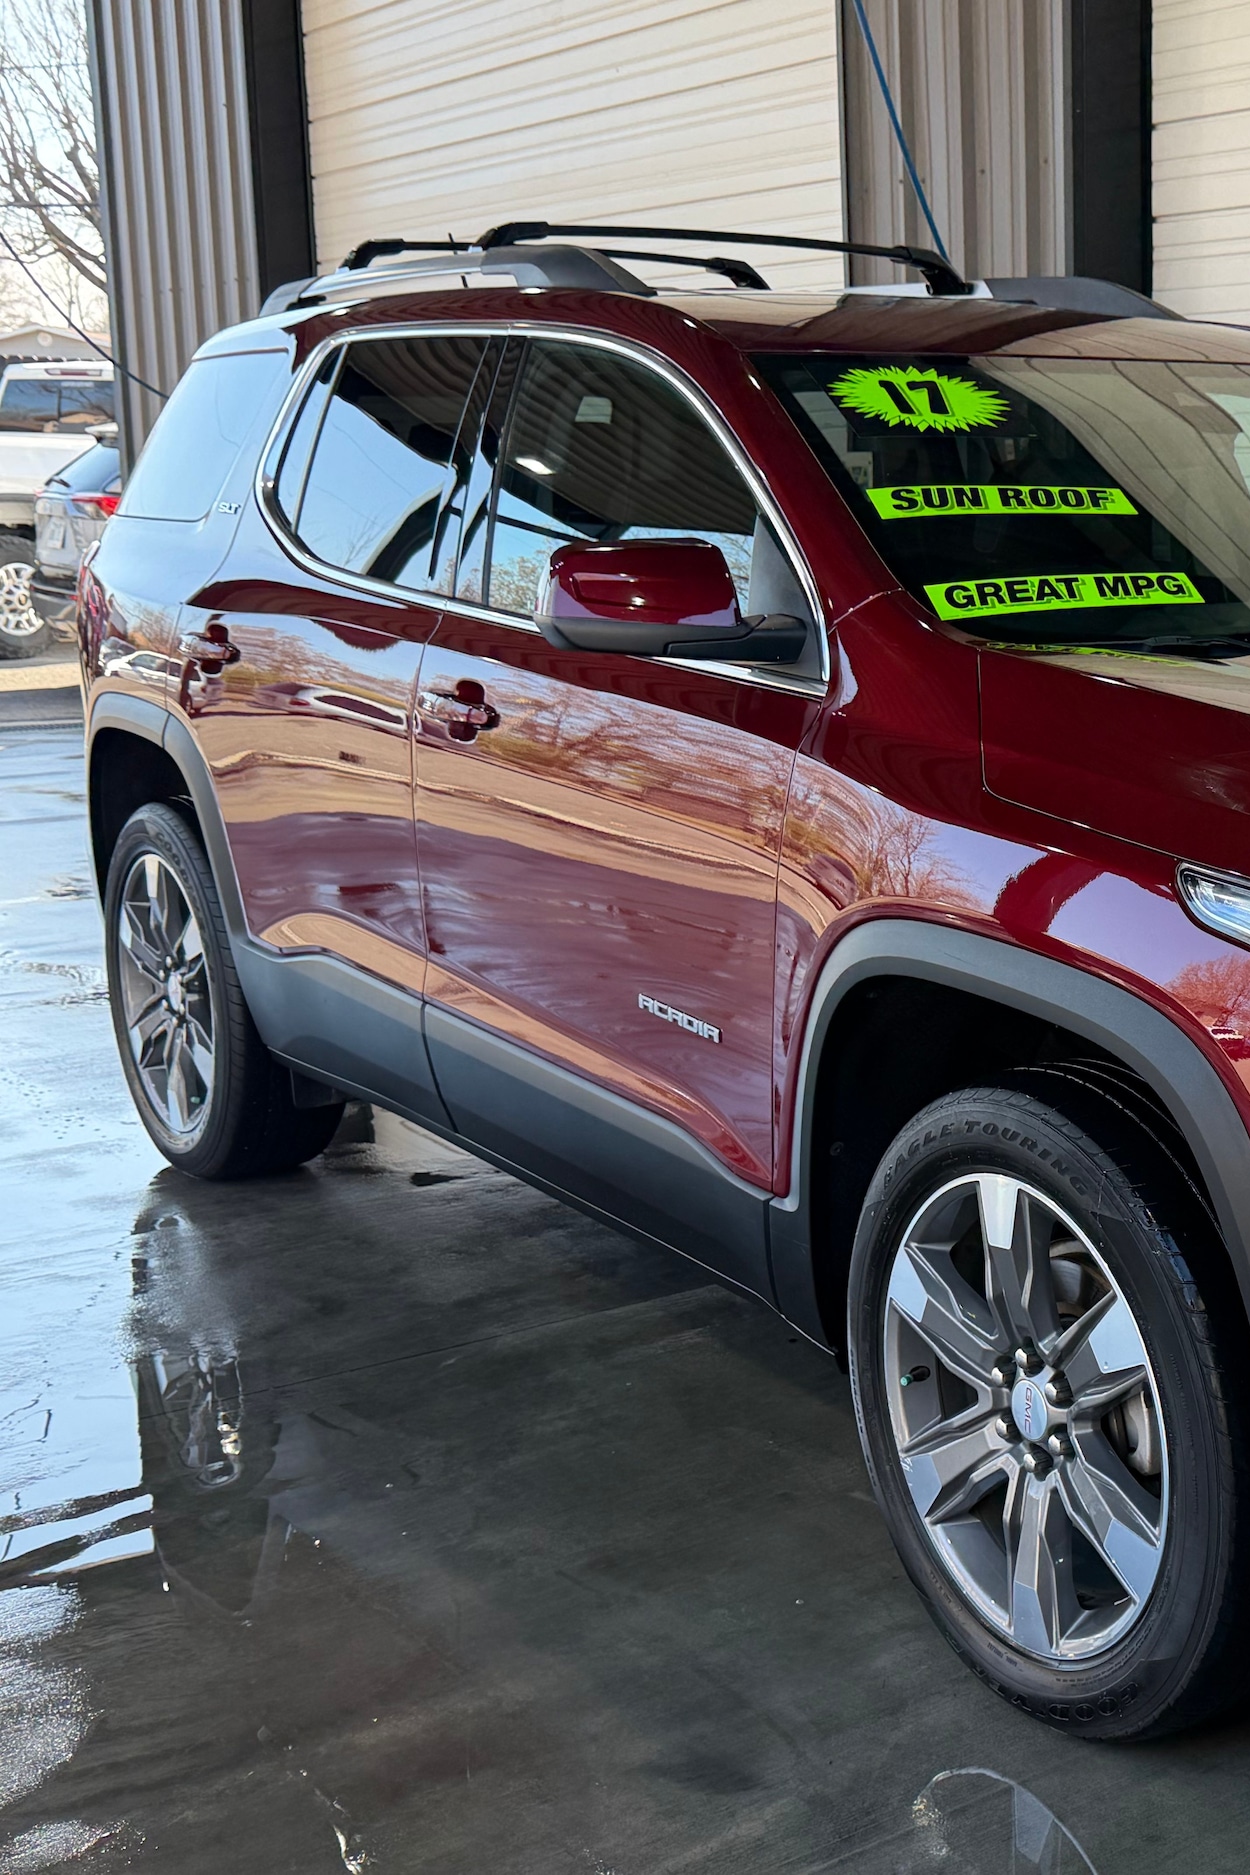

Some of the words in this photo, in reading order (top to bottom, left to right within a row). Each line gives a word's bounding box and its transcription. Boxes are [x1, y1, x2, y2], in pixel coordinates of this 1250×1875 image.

[878, 379, 954, 416] 17
[217, 501, 241, 515] SLT
[890, 486, 986, 512] SUN
[999, 487, 1114, 510] ROOF
[944, 576, 1082, 610] GREAT
[1096, 574, 1188, 600] MPG
[638, 992, 721, 1044] ACADIA
[883, 1121, 956, 1190] EAGLE
[963, 1118, 1089, 1196] TOURING
[1024, 1386, 1033, 1434] GMC
